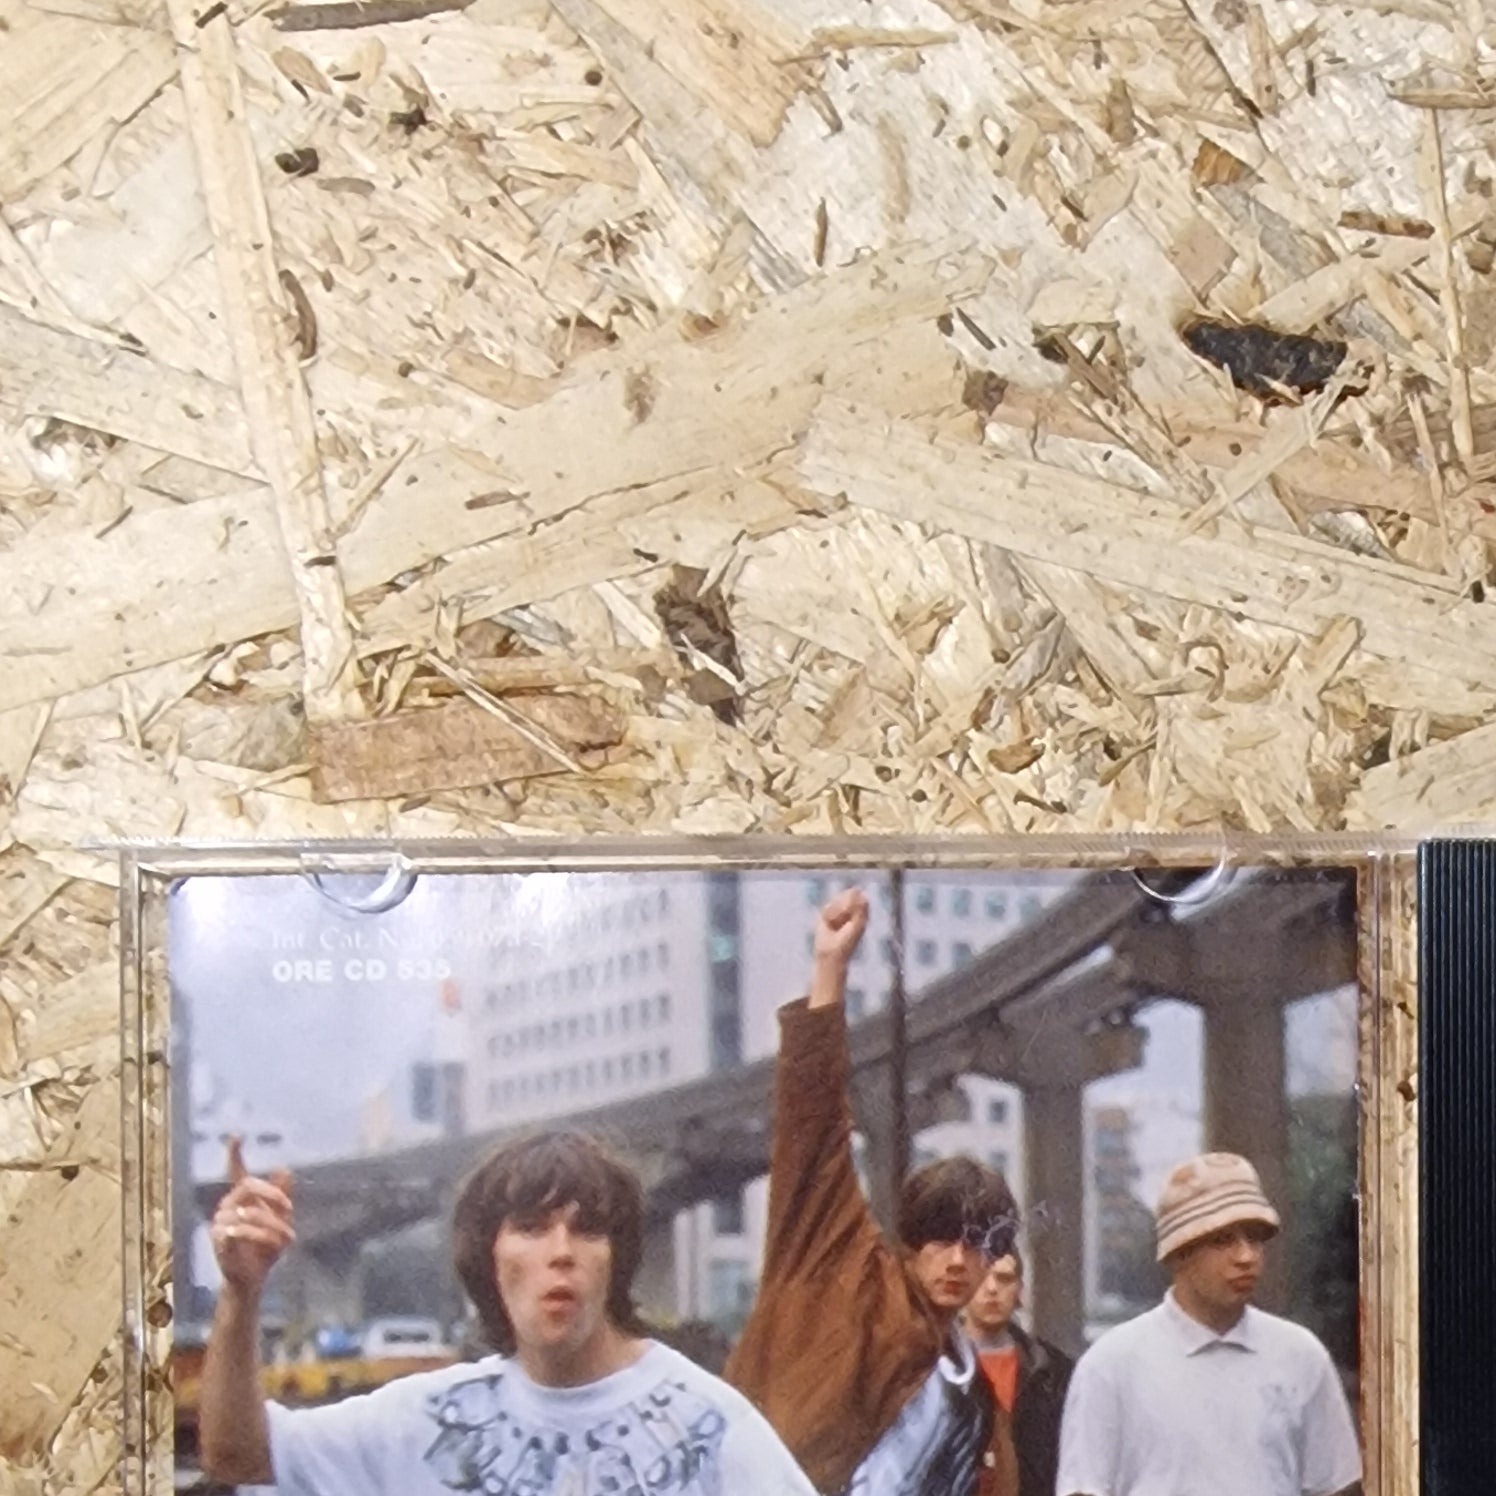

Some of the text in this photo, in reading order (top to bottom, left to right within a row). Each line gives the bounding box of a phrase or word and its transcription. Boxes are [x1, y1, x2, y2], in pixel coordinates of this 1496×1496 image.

[272, 958, 451, 982] ORE CD 535
